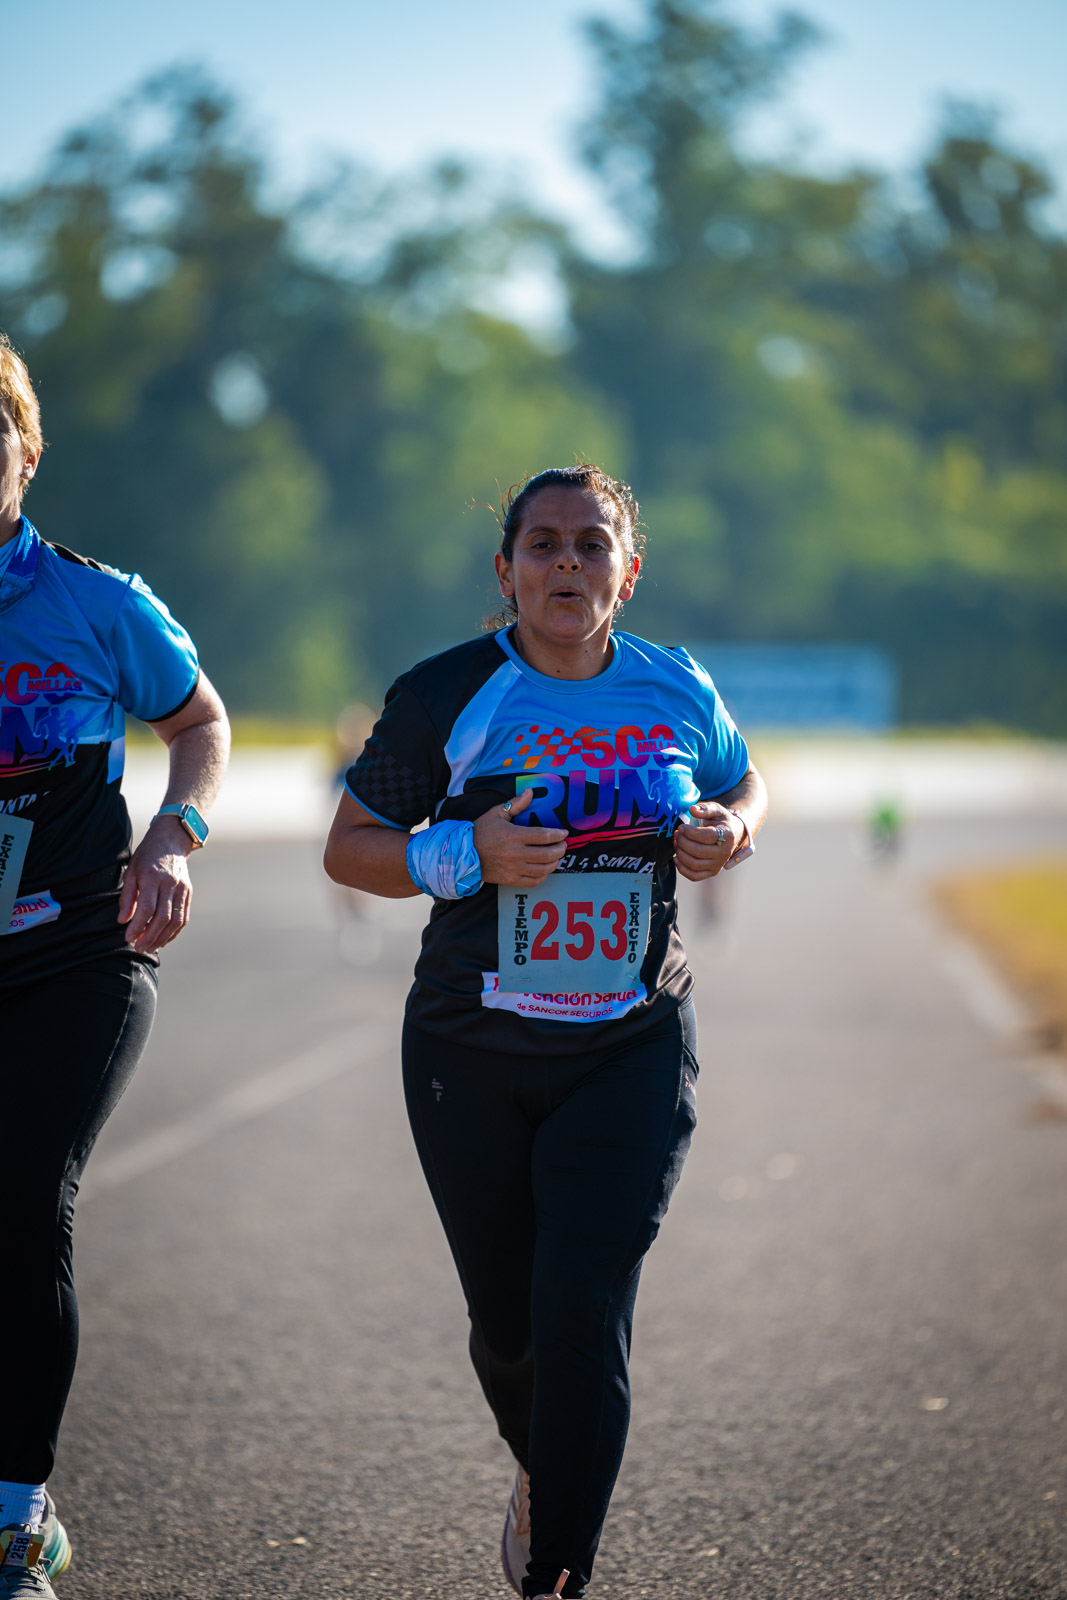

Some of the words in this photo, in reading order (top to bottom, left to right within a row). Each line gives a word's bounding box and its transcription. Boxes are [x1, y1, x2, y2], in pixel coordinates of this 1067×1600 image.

[27, 680, 83, 692] MILLAS
[513, 770, 663, 830] RUN
[12, 898, 50, 916] alud
[513, 894, 529, 966] TIEMPO
[530, 900, 628, 961] 253
[627, 892, 640, 964] EXACTO
[516, 1002, 526, 1011] de
[528, 1004, 569, 1016] SANCOR
[569, 1006, 614, 1018] SEGUROS
[10, 1538, 29, 1559] 258
